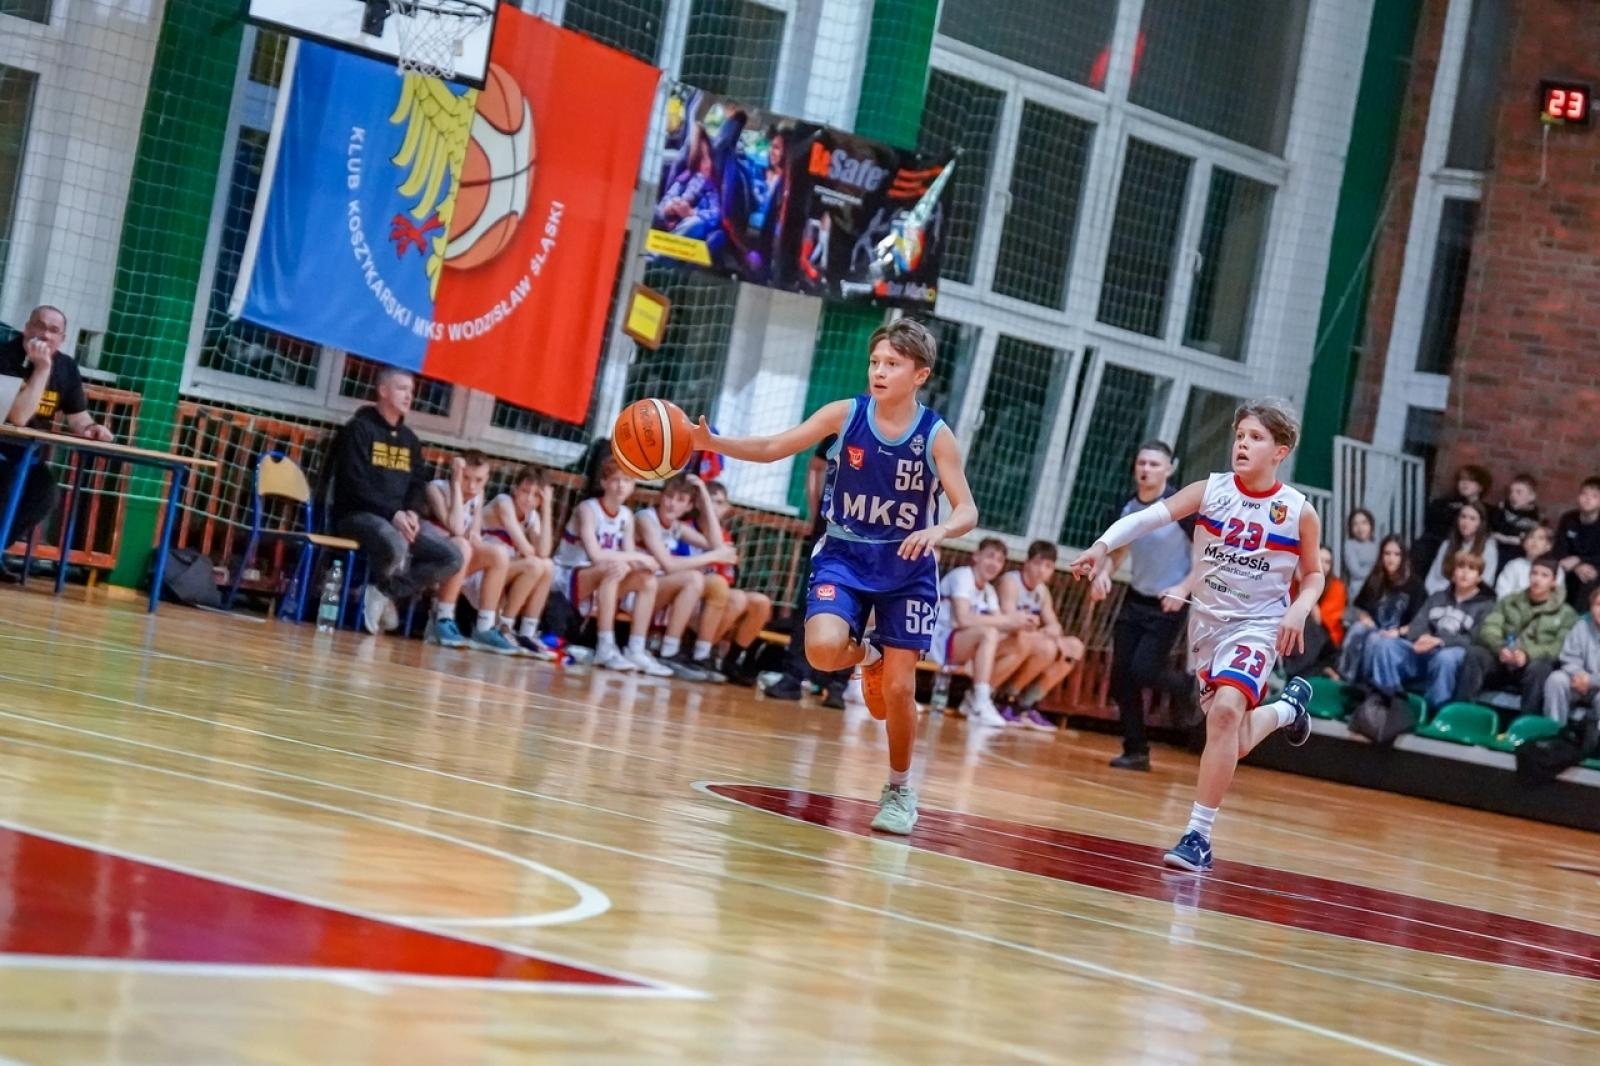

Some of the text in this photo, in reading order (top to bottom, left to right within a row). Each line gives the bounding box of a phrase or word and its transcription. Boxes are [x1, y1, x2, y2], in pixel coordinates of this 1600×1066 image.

[1549, 89, 1585, 119] 23
[347, 126, 366, 190] KLUB
[348, 199, 412, 327] KOSZYKARSKI
[411, 316, 446, 341] MKS
[894, 458, 924, 491] 52
[842, 491, 919, 530] MKS
[1224, 517, 1265, 551] 23
[905, 599, 935, 636] 52
[1229, 644, 1266, 678] 23
